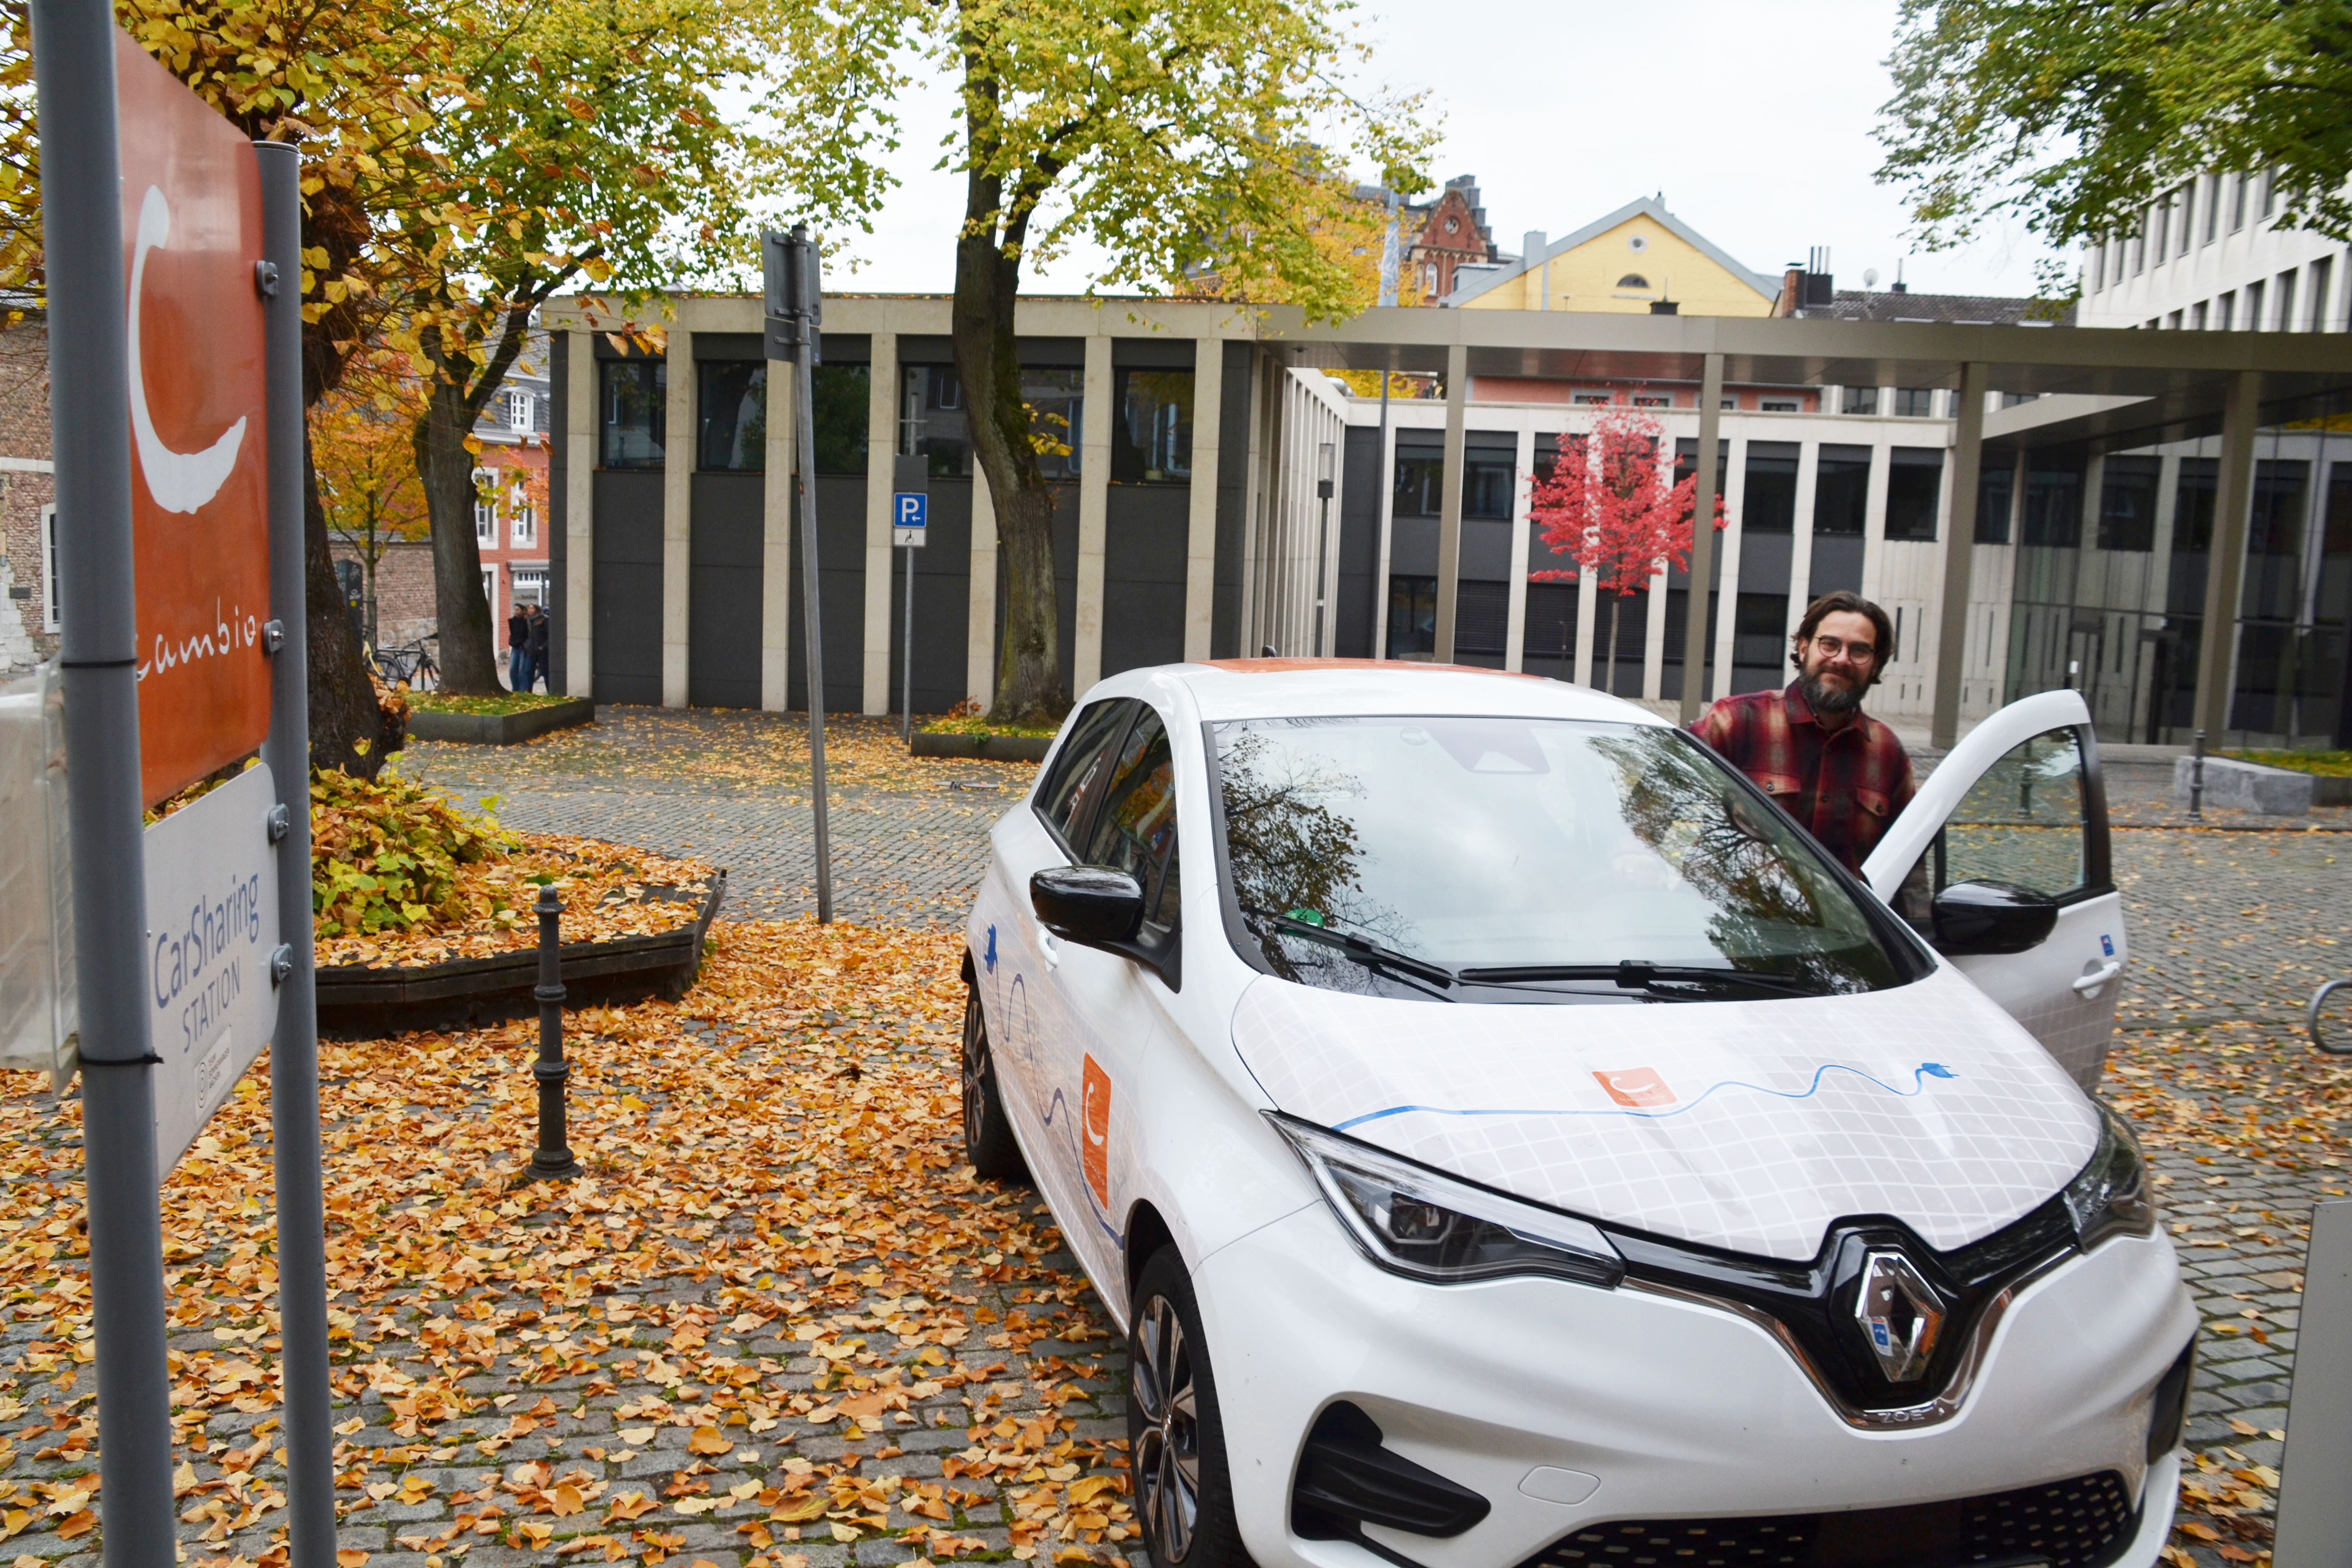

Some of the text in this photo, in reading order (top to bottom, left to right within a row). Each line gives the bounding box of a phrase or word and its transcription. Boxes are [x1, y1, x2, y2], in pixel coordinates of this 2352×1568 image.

[902, 497, 919, 522] P
[155, 873, 259, 1009] CarSharing
[183, 955, 240, 1053] STATION
[1877, 1409, 1925, 1424] ZOE
